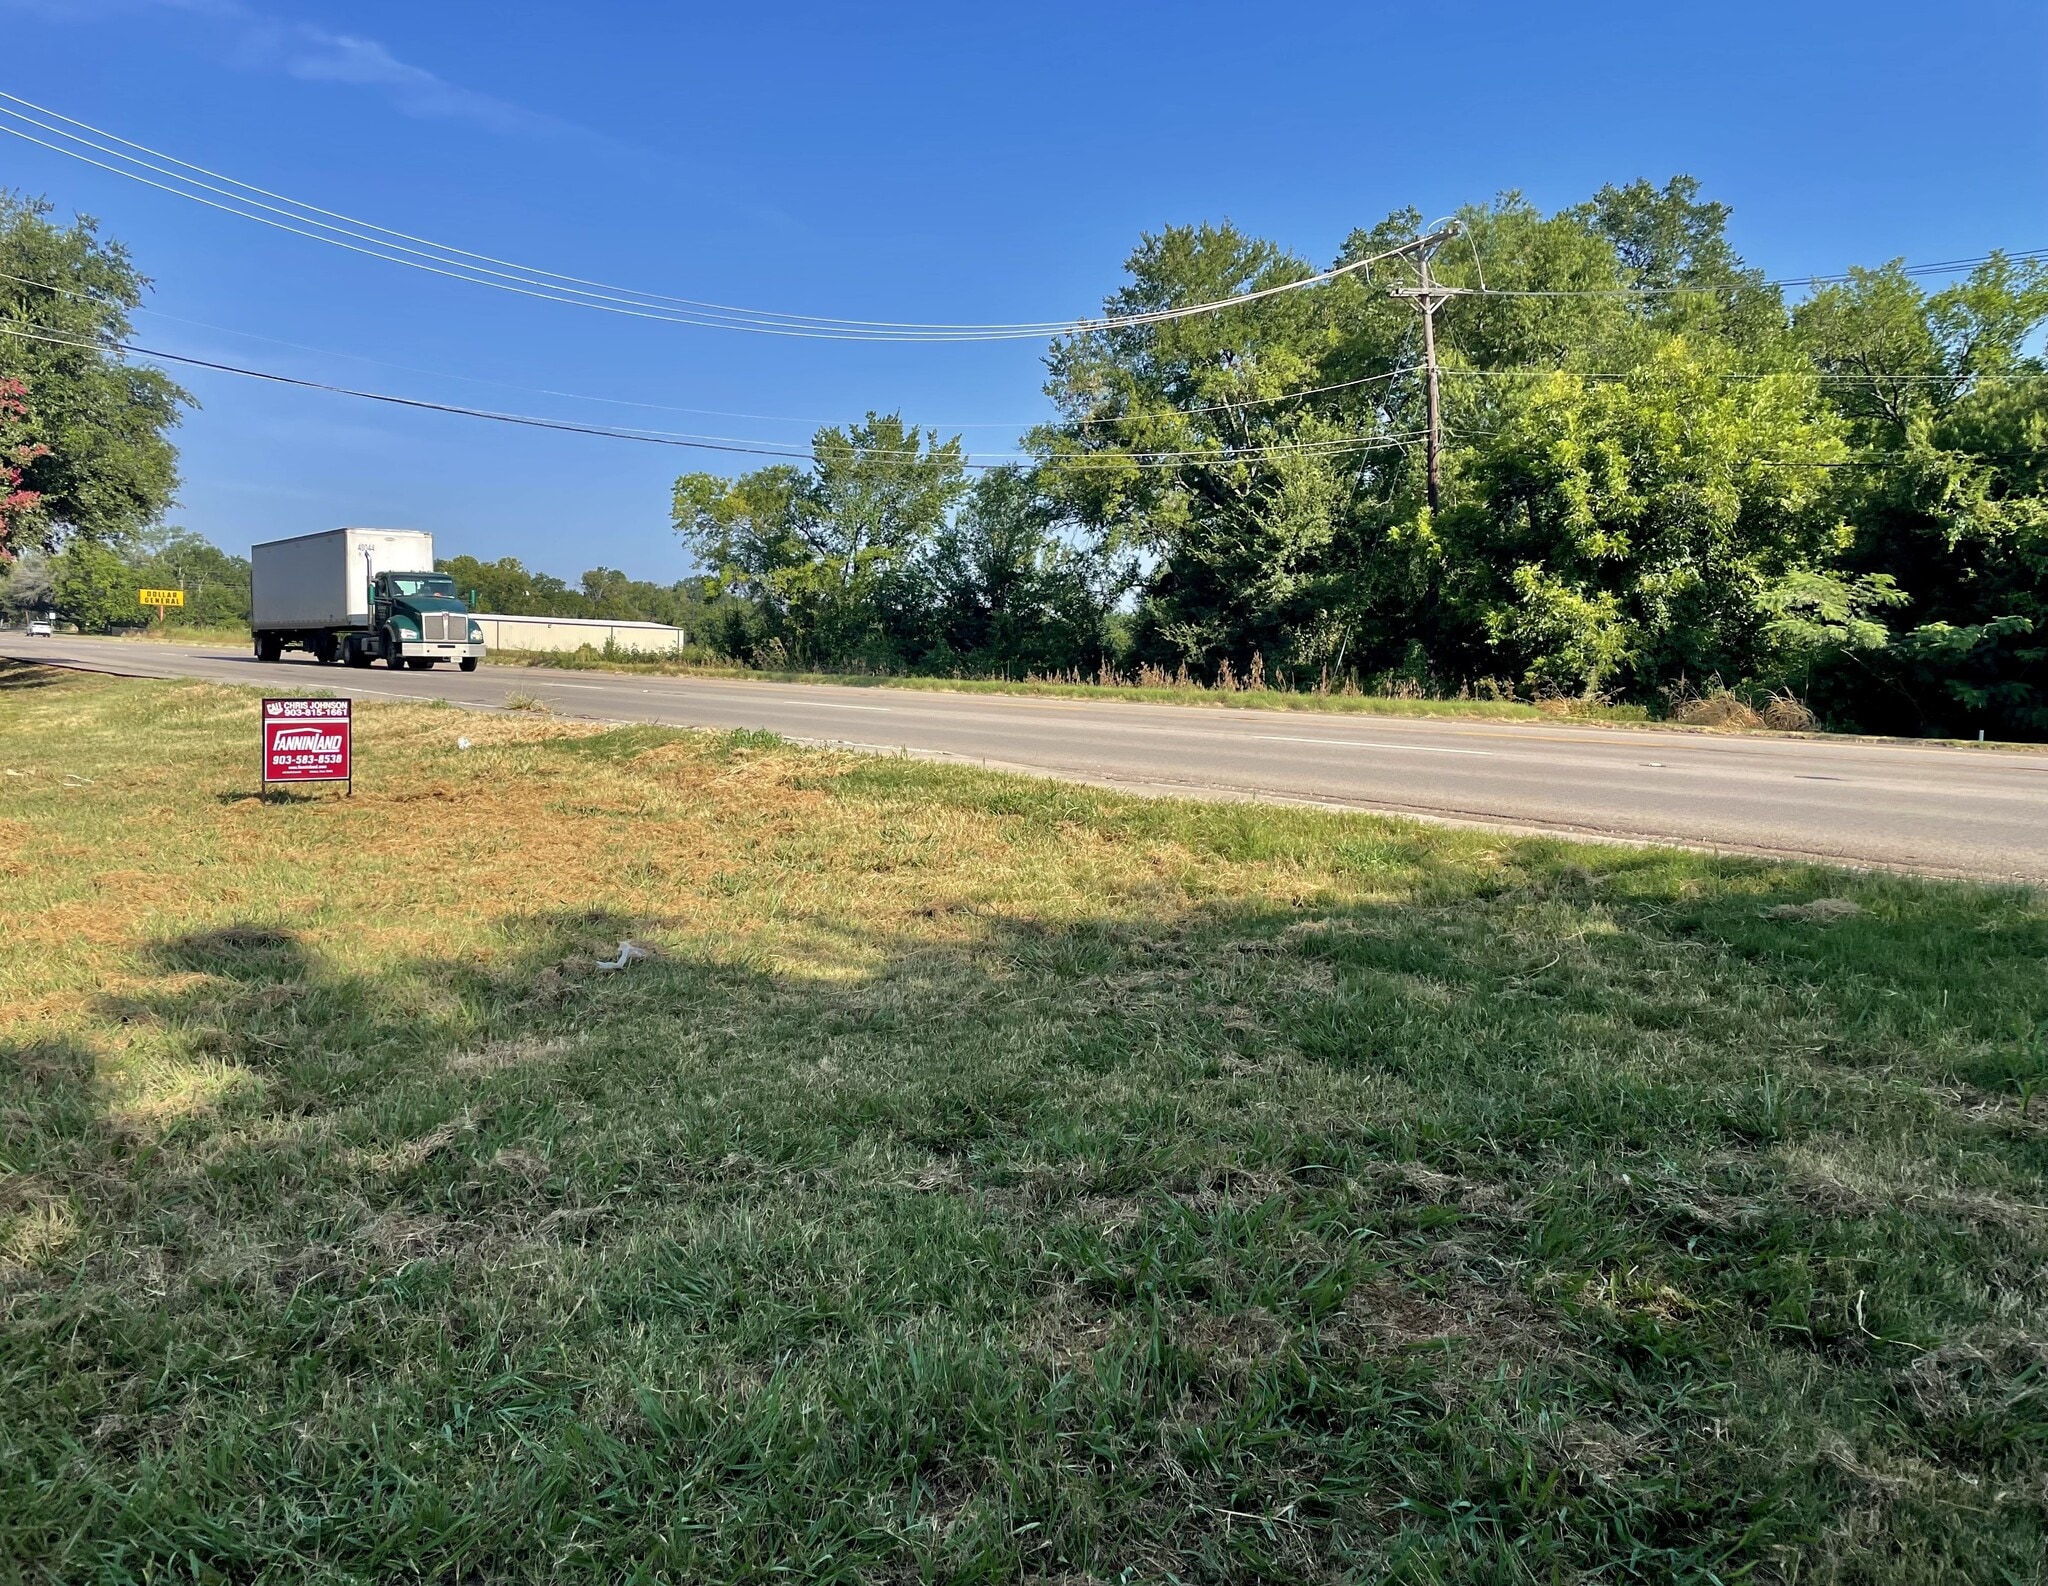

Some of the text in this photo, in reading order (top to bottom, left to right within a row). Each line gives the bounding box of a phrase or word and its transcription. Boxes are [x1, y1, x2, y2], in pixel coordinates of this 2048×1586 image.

[144, 597, 180, 605] GENERAL
[267, 701, 283, 712] CALL
[283, 701, 348, 709] CHRIS JOHNSON
[284, 708, 348, 716] 903-815-1661
[272, 754, 343, 765] 903-583-8538
